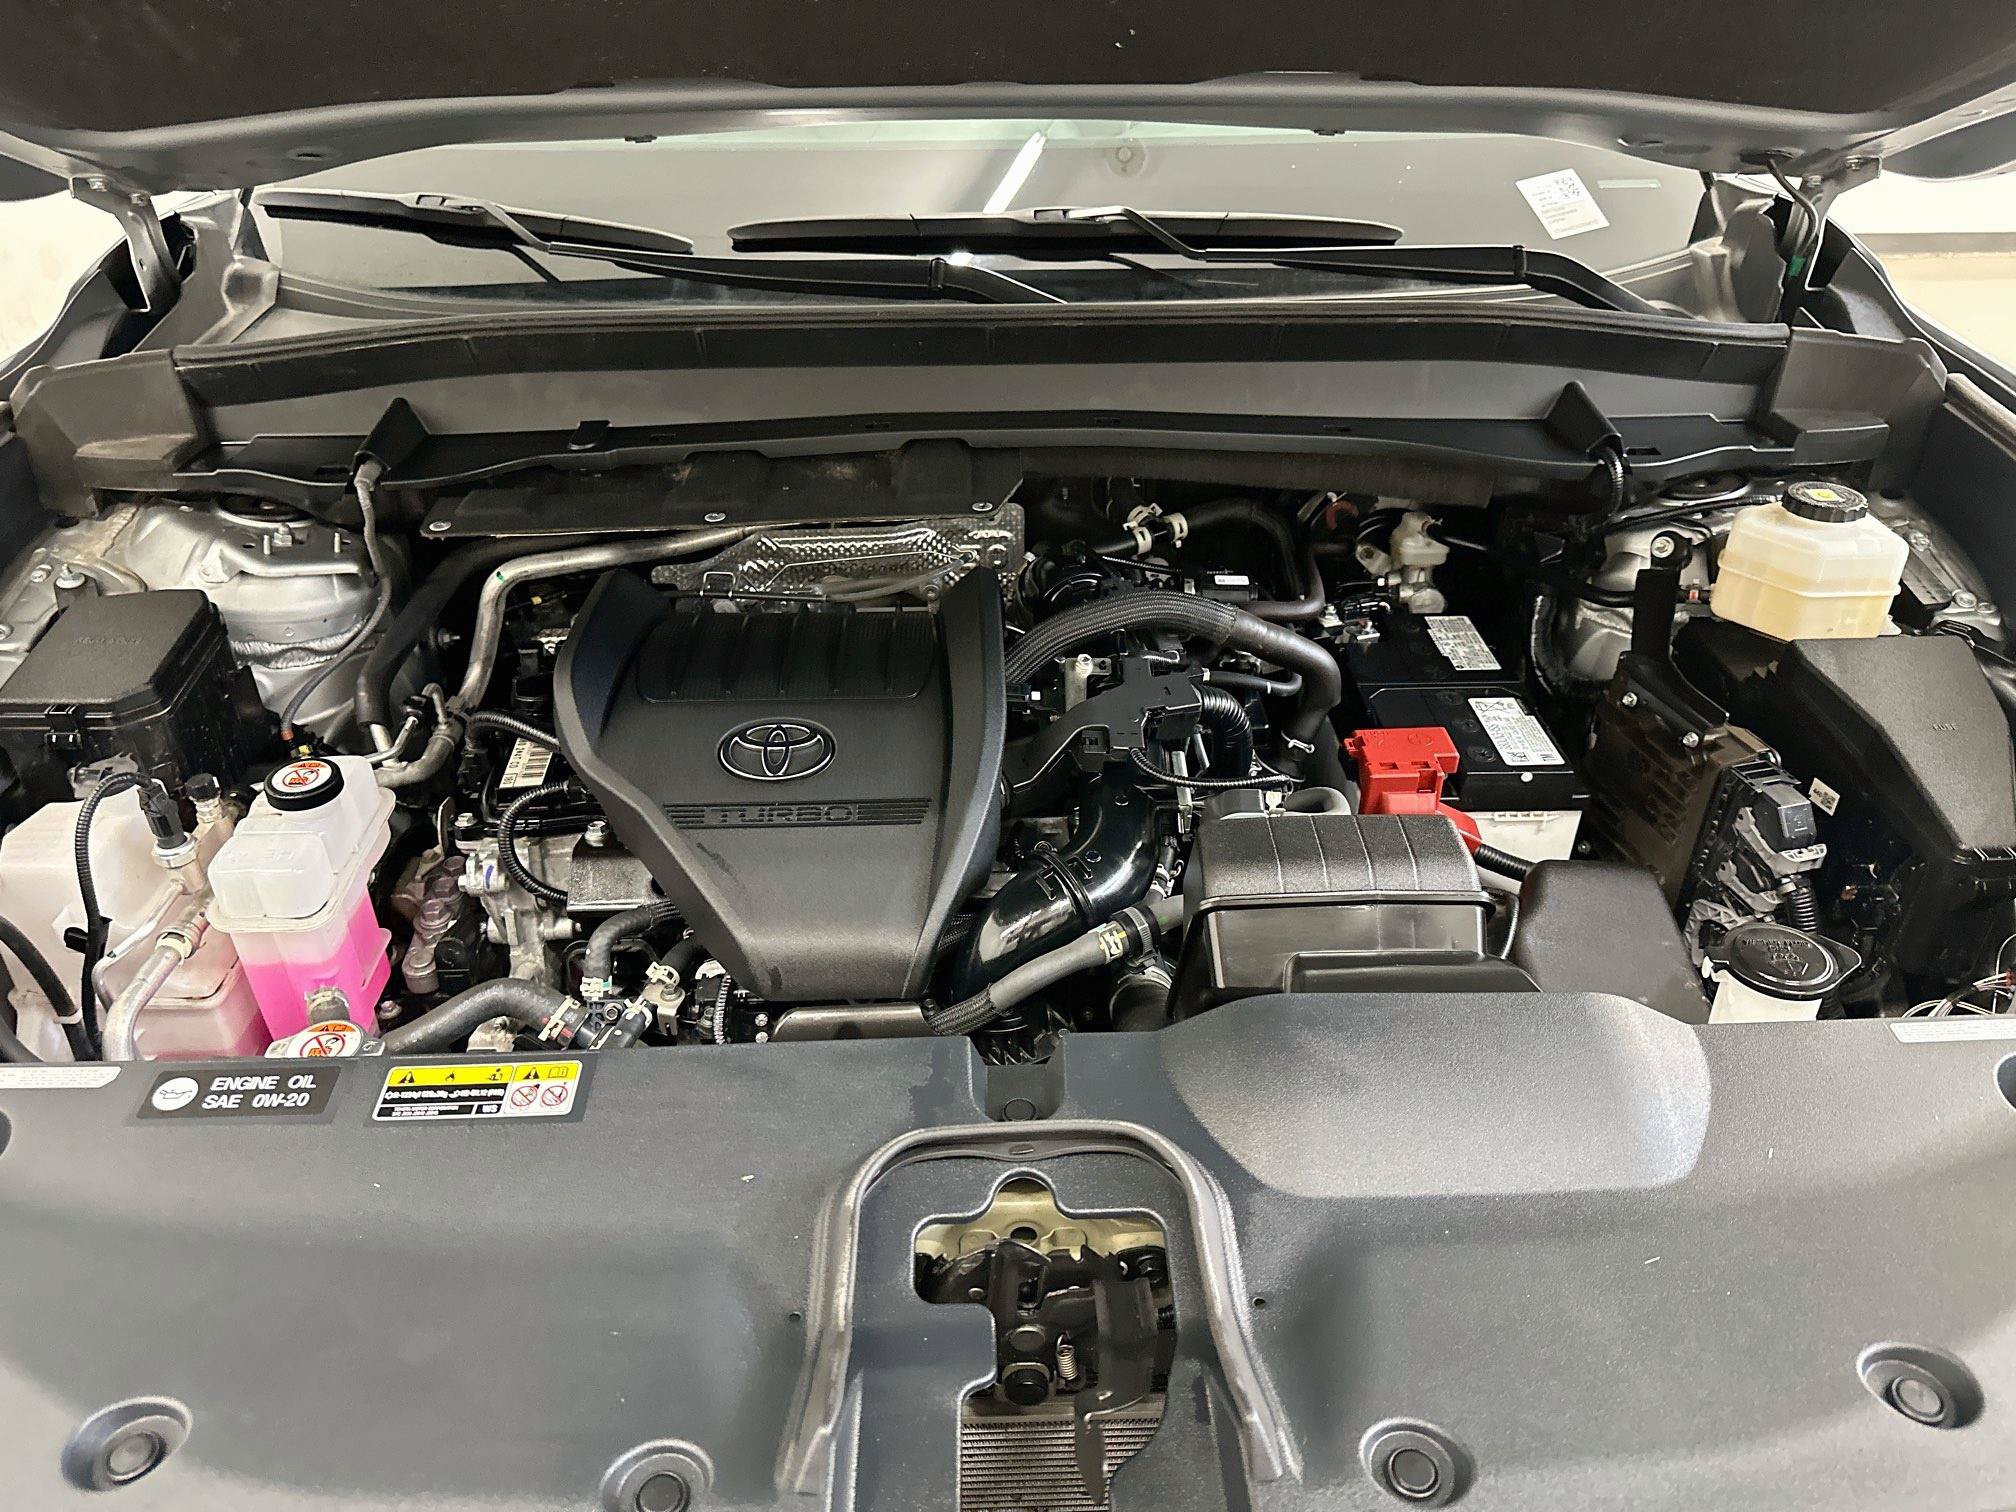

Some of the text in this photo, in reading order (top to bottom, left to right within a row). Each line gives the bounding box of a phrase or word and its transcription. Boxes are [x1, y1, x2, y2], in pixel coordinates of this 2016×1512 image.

[708, 806, 853, 823] TURBO
[210, 1074, 317, 1091] ENGINE OIL
[201, 1092, 311, 1109] SAE 0W-20
